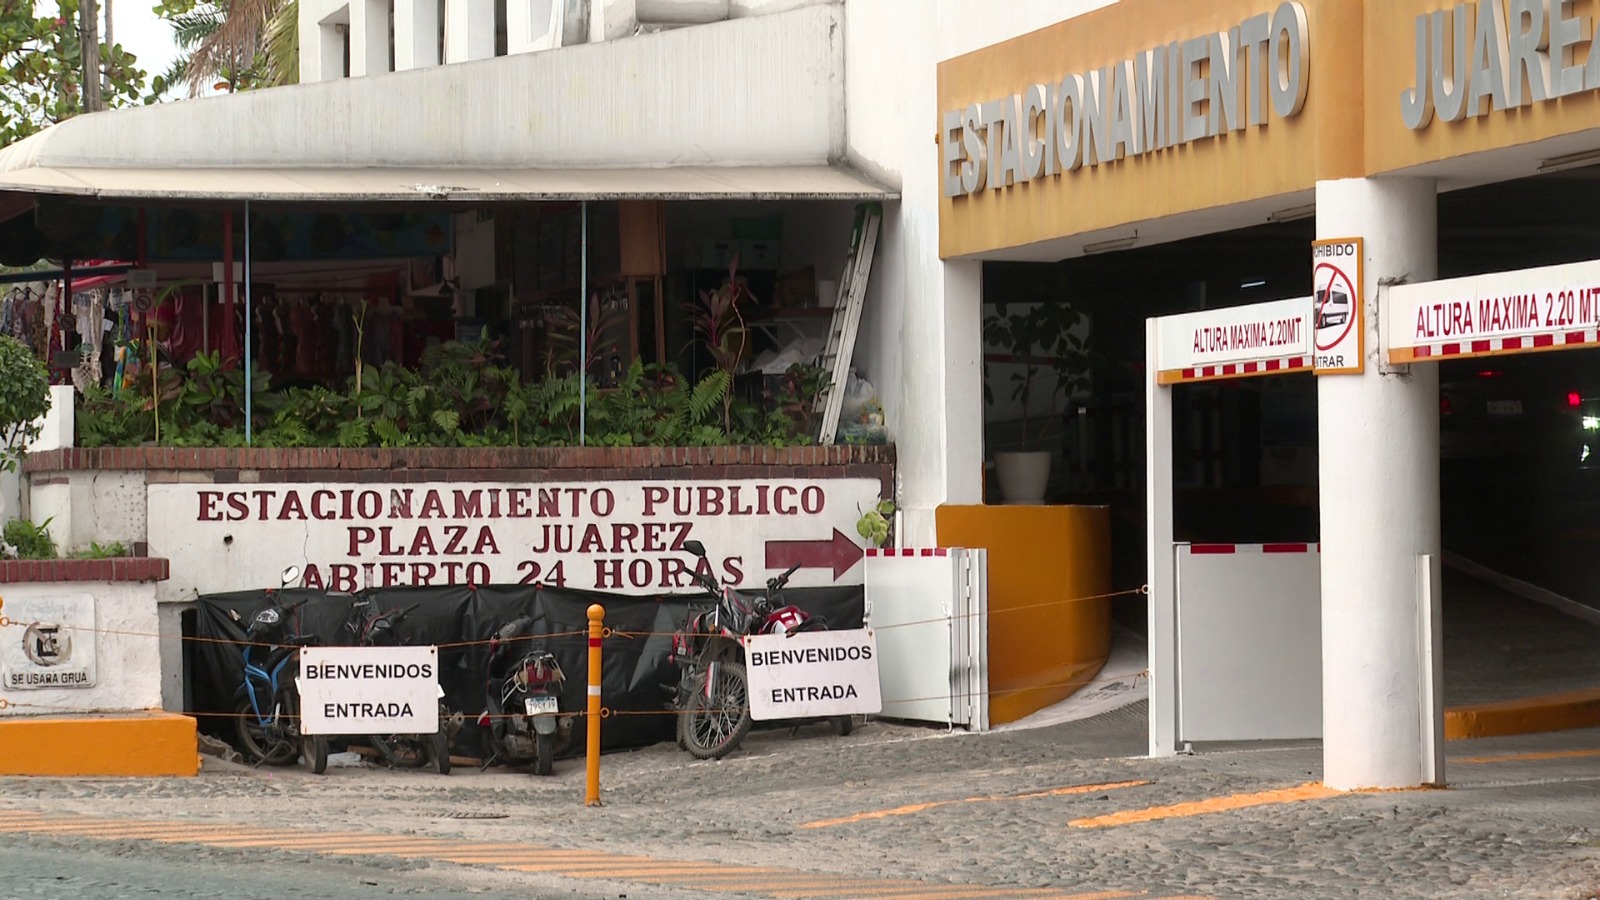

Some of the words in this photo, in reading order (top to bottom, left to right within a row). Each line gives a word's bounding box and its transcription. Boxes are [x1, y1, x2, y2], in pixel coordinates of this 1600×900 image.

[943, 1, 1309, 198] ESTACIONAMIENTO
[1416, 301, 1473, 338] ALTURA
[1479, 293, 1539, 333] MAXIMA
[1545, 290, 1574, 327] 2.20
[1579, 287, 1600, 324] MT
[1193, 326, 1228, 353] ALTURA
[1230, 321, 1267, 350] MAXIMA
[197, 488, 615, 520] ESTACIONAMIENTO
[642, 485, 825, 517] PUBLICO
[347, 525, 501, 556] PLAZA
[533, 522, 693, 554] JUAREZ
[302, 561, 491, 593] ABIERTO
[516, 559, 567, 588] 24
[594, 556, 744, 589] HORAS
[306, 664, 432, 680] BIENVENIDOS
[752, 645, 872, 667] BIENVENIDOS
[11, 673, 24, 685] SE
[26, 673, 59, 684] USARA
[61, 672, 87, 683] GRUA
[771, 684, 858, 703] ENTRADA
[324, 703, 413, 718] ENTRADA
